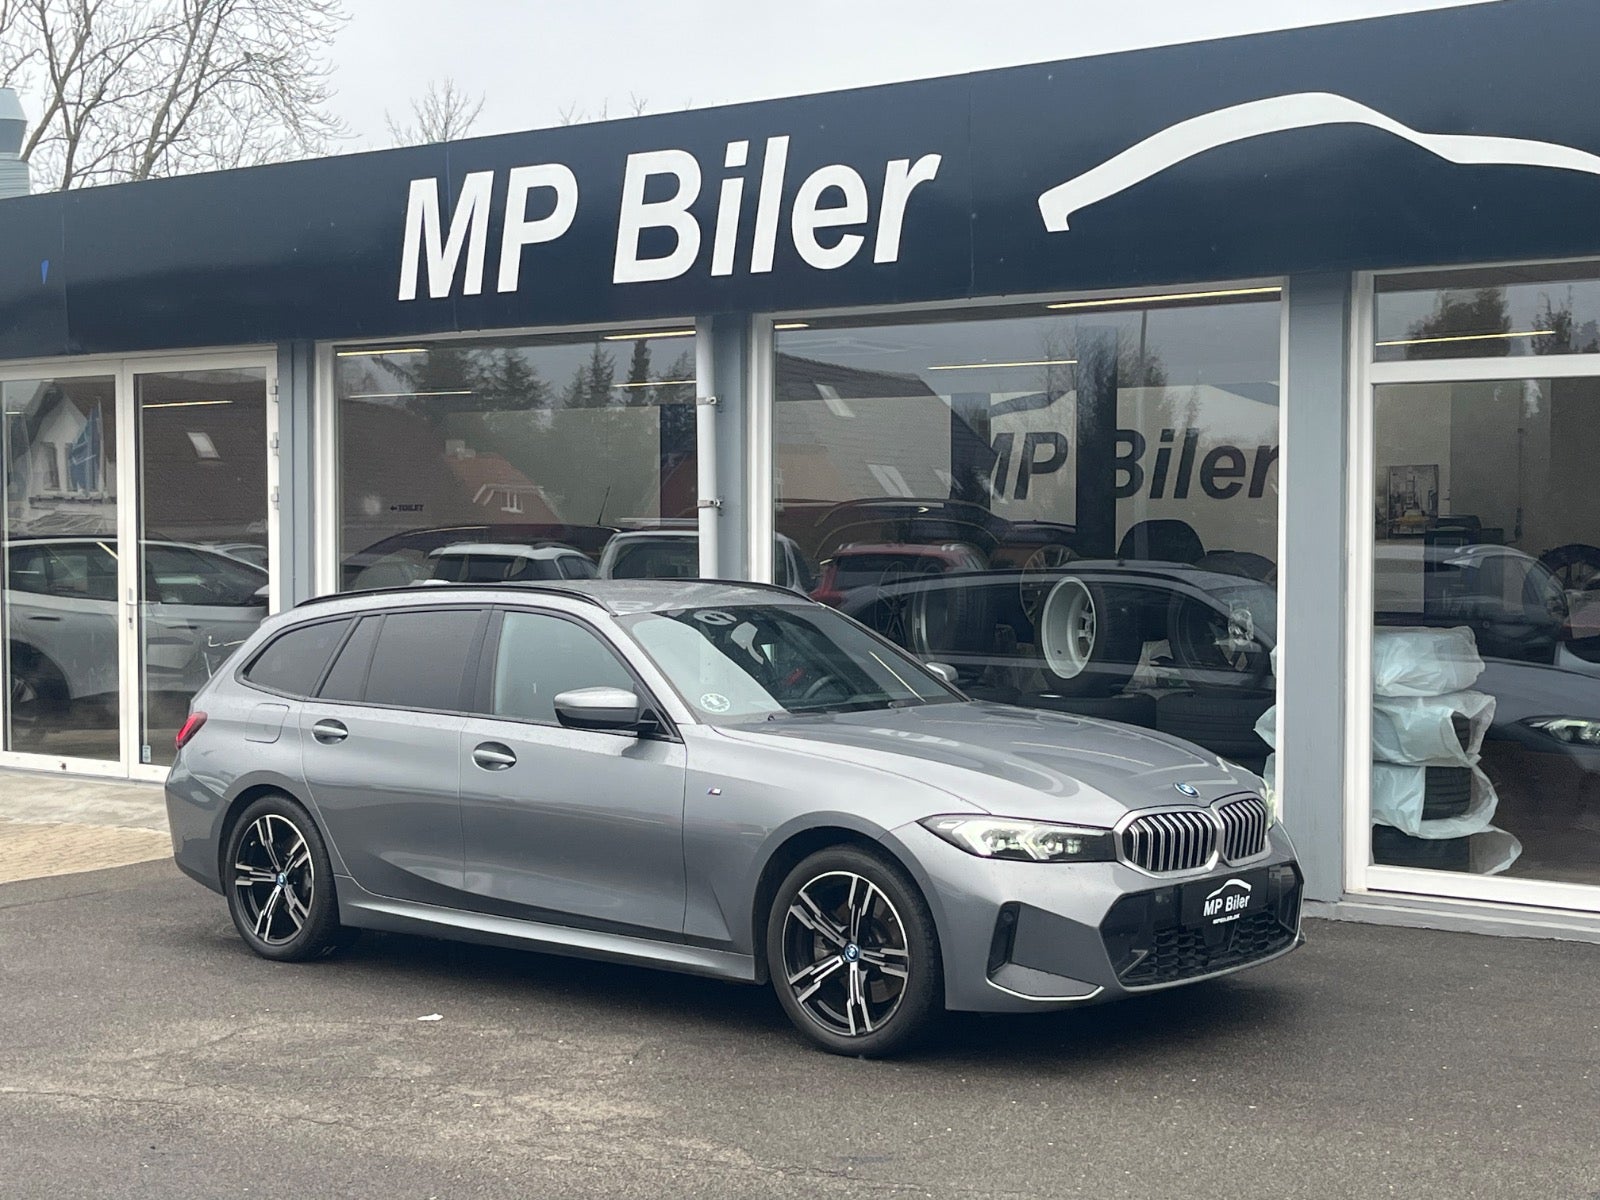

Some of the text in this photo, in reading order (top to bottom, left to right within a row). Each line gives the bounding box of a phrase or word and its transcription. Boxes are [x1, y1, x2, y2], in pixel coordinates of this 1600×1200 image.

[398, 135, 942, 301] MP Biler
[1115, 428, 1279, 500] Biler
[1203, 893, 1250, 916] MP Biler
